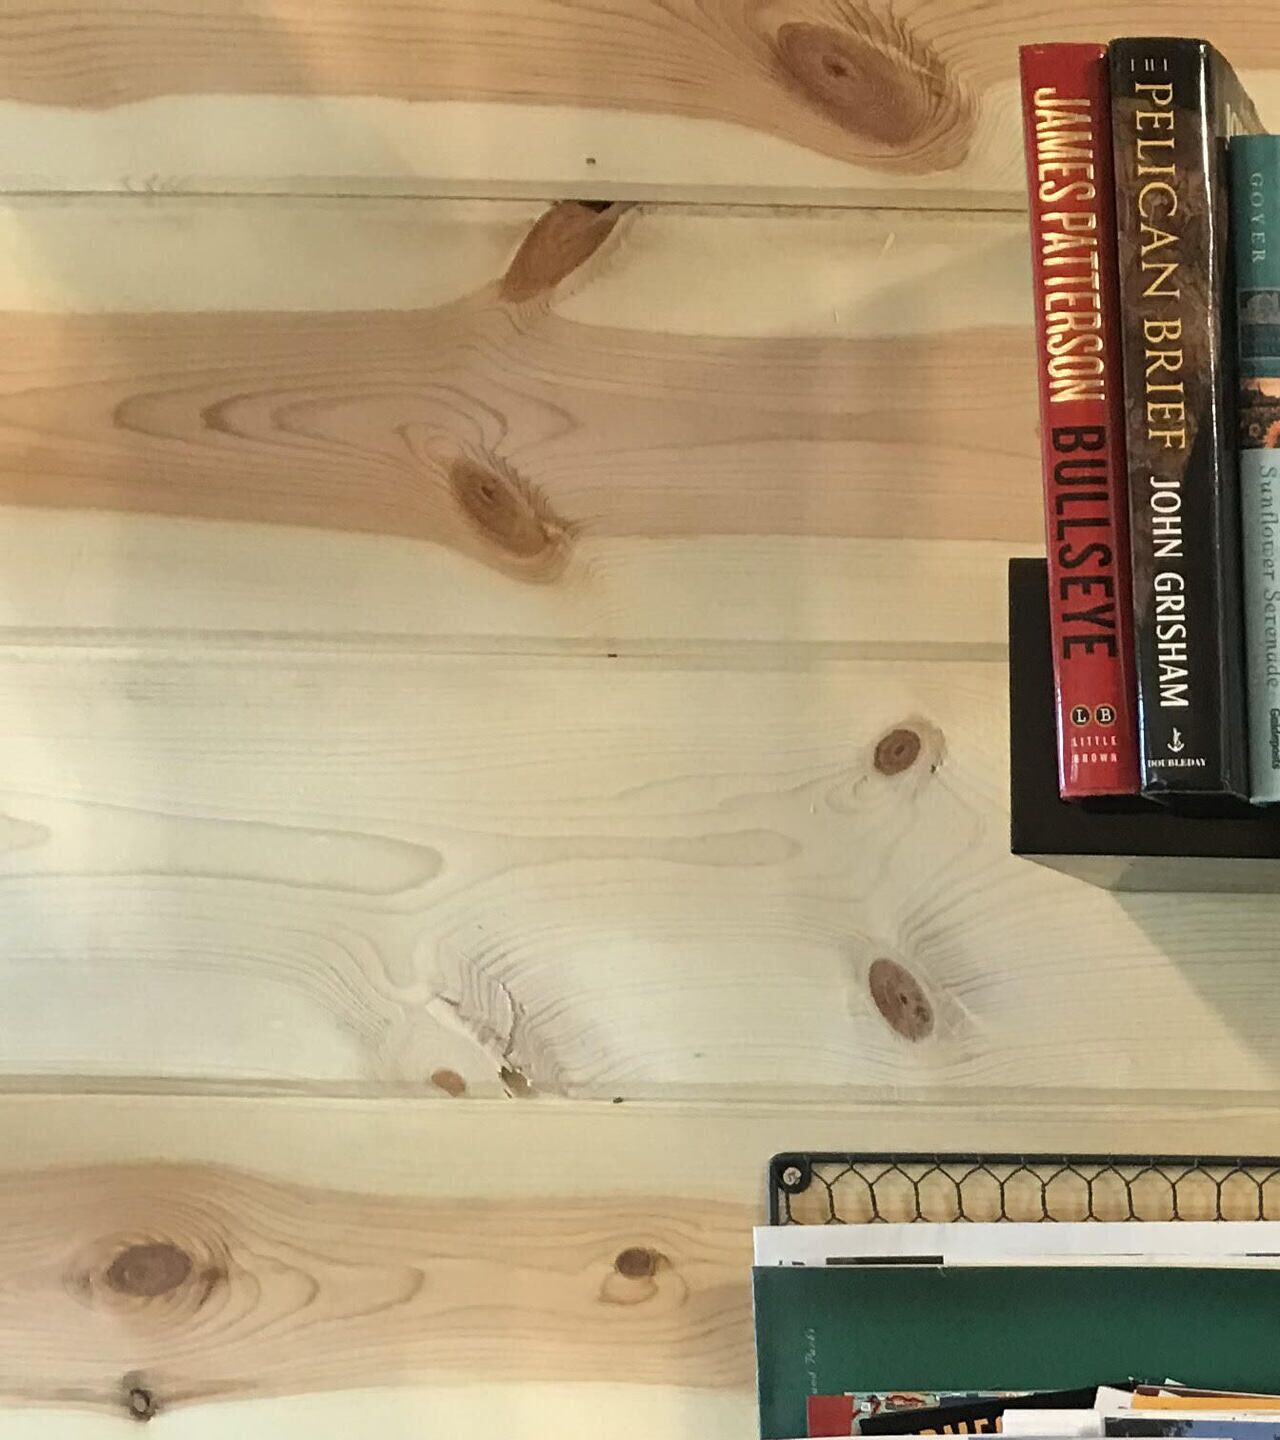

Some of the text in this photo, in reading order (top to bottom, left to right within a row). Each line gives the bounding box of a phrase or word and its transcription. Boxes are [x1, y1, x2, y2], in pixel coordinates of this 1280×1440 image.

[1033, 87, 1105, 402] JAMES PATTERSON
[1135, 83, 1187, 449] PELICAN BRIEF
[1251, 172, 1266, 264] GOYER
[1052, 426, 1117, 660] BULLSEYE
[1150, 476, 1190, 708] JOHN GRISHAM
[1259, 464, 1279, 582] Sunflower
[1147, 757, 1207, 768] DOUBLEDAY
